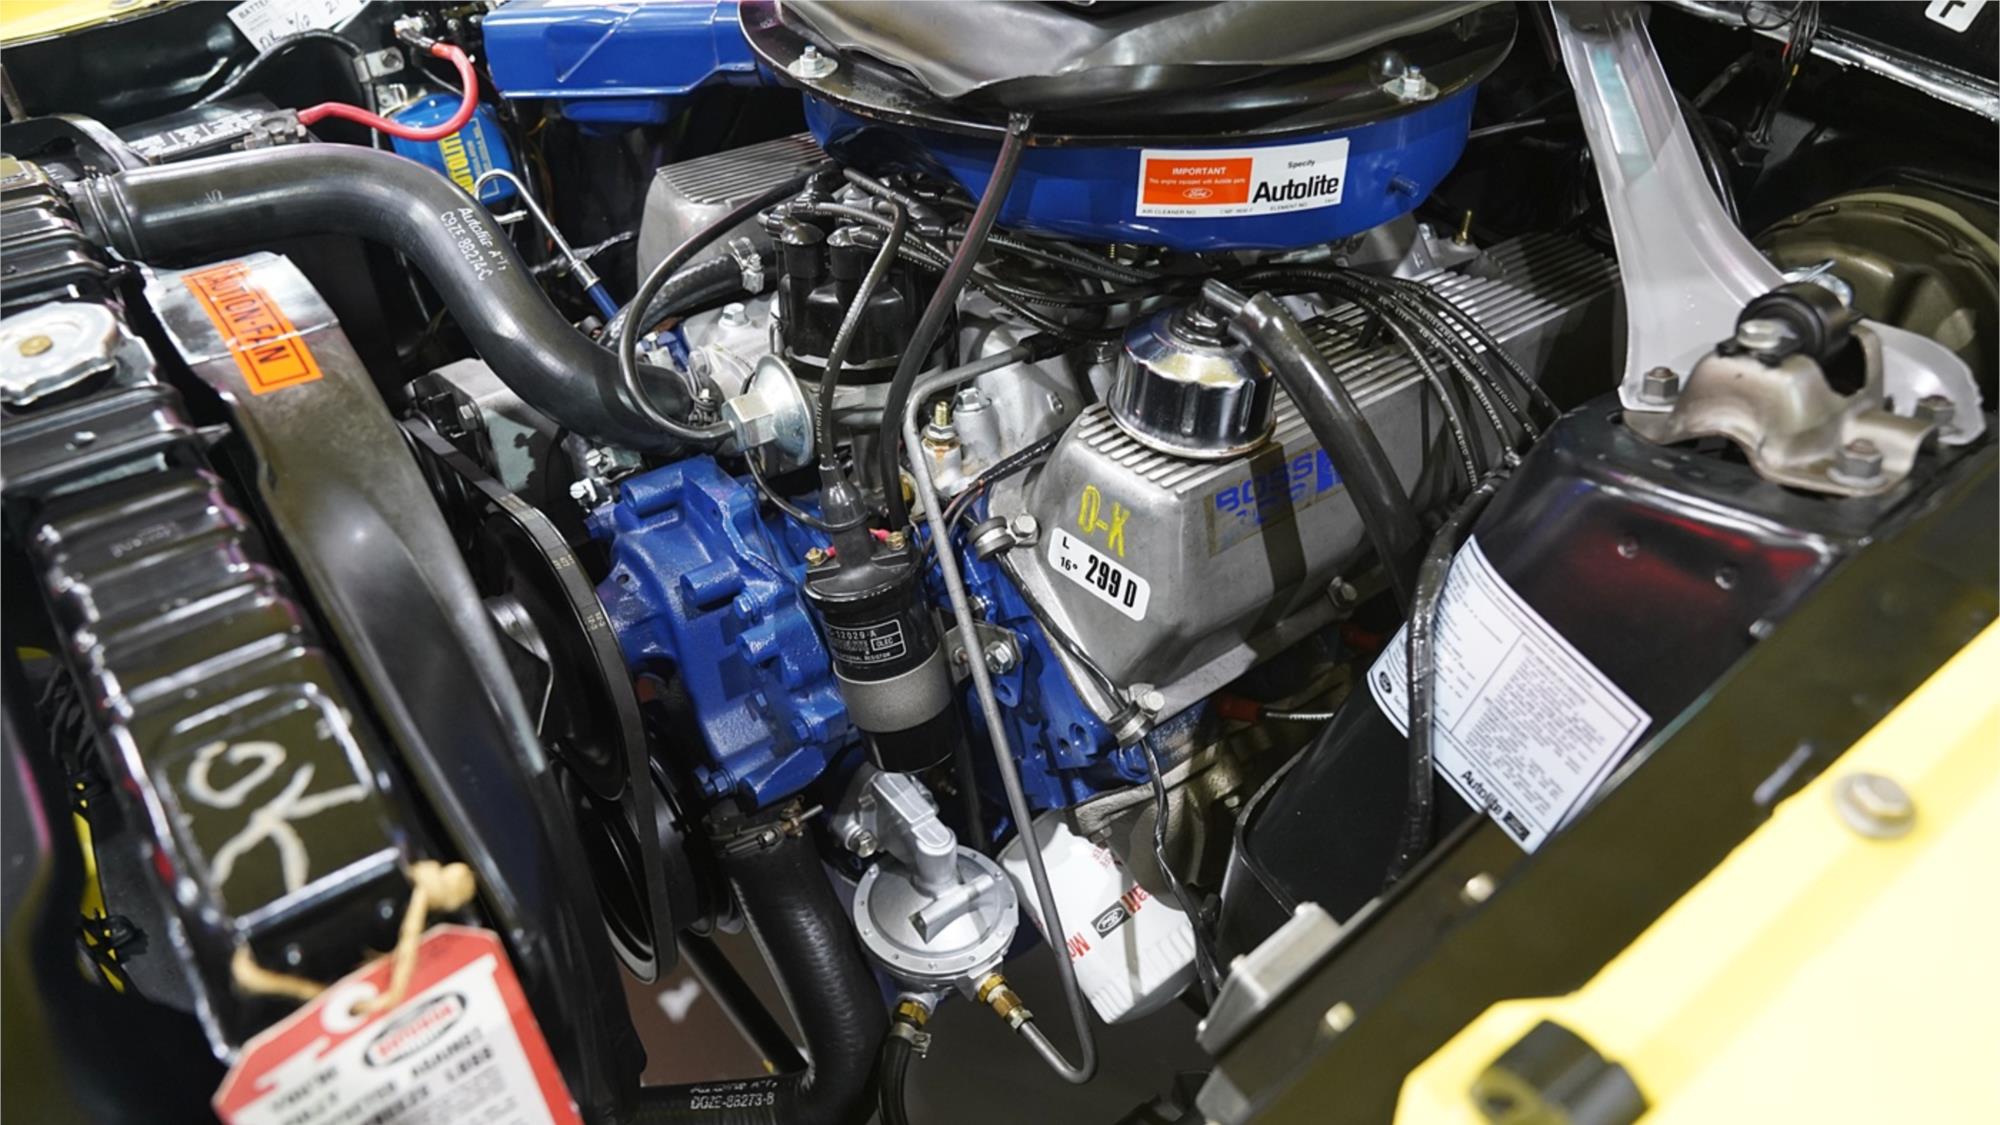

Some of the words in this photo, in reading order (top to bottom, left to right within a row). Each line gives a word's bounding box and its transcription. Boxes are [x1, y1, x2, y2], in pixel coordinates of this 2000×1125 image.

[1172, 167, 1226, 176] IMPORTANT
[1288, 160, 1315, 169] Specify
[1252, 174, 1339, 203] Autolite
[1473, 384, 1502, 430] RESISTANCE
[1062, 536, 1070, 550] L
[1085, 554, 1122, 598] 299
